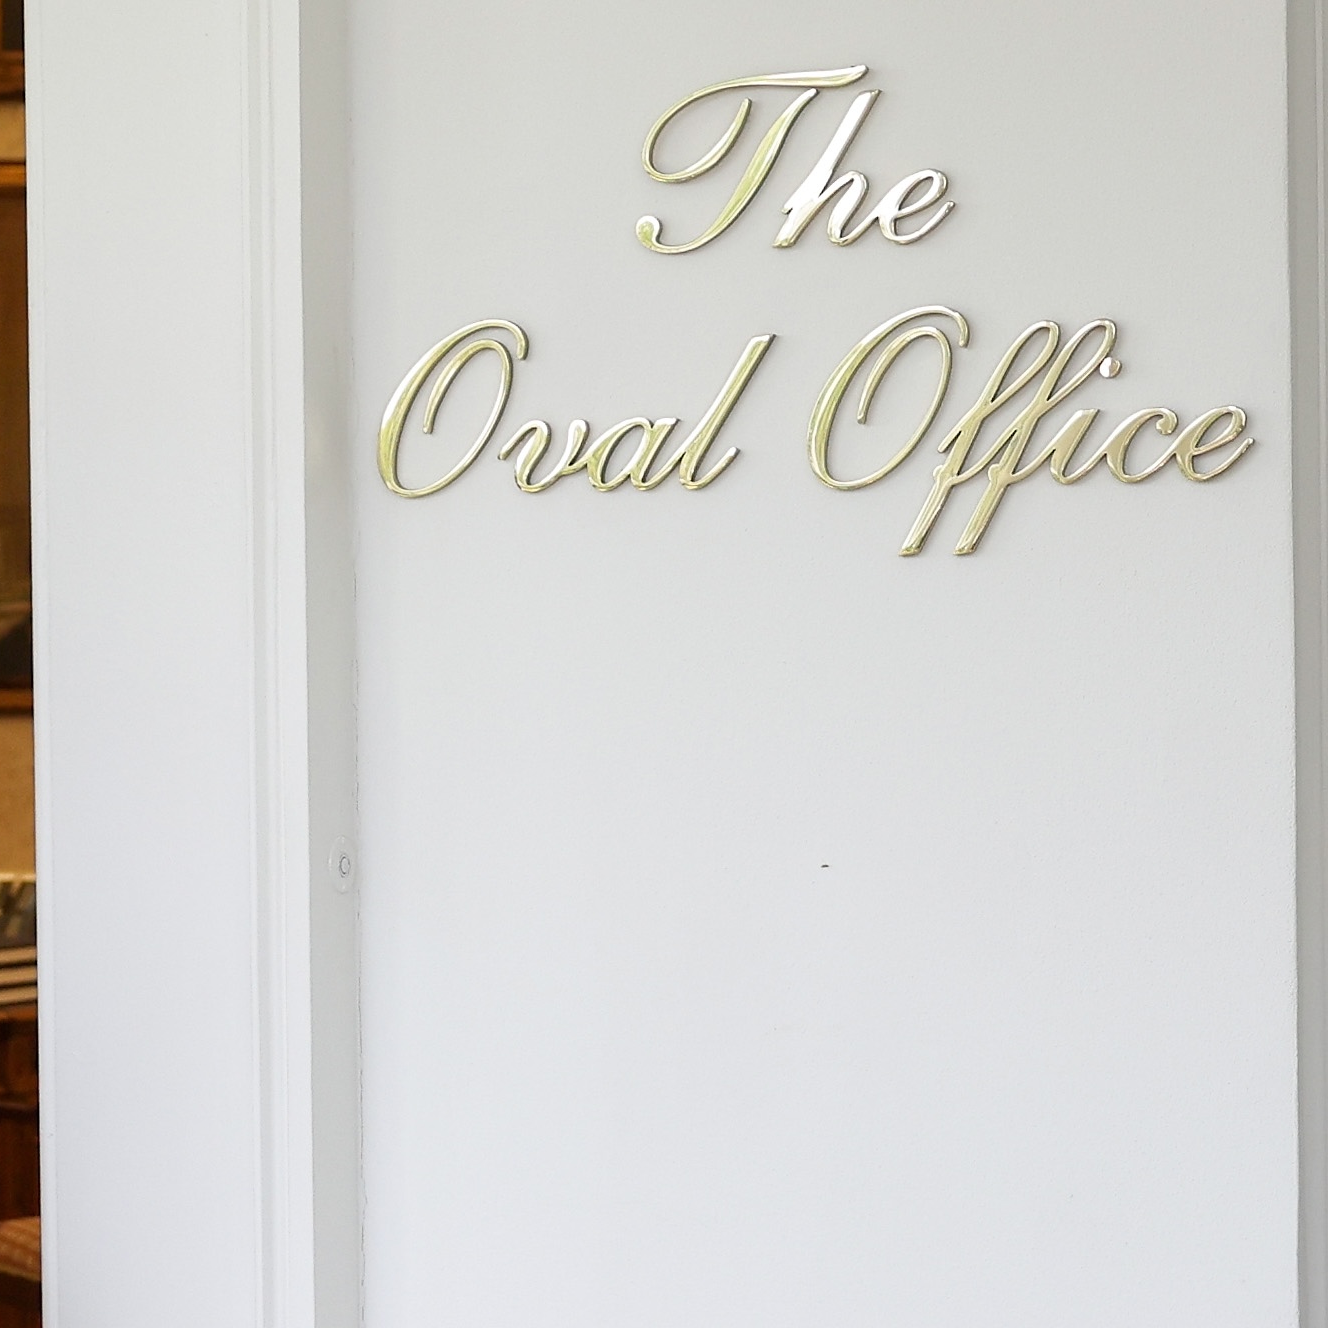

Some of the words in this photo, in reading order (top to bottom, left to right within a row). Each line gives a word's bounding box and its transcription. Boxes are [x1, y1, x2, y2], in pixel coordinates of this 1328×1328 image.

[635, 64, 956, 255] The
[377, 318, 778, 499] Oval
[805, 303, 1256, 558] Office
